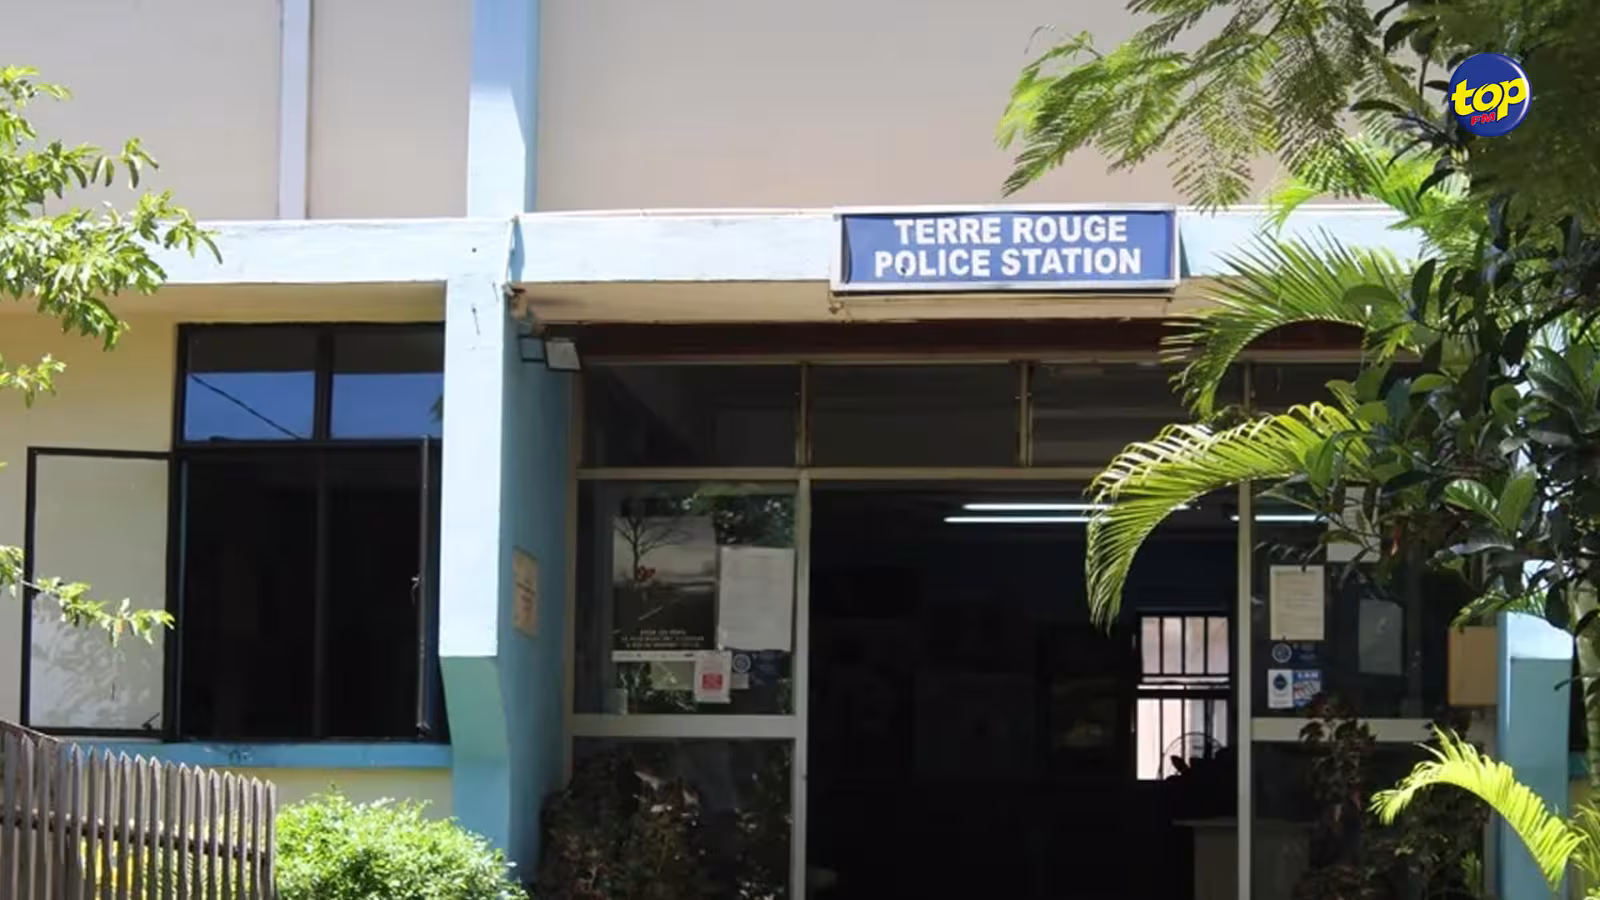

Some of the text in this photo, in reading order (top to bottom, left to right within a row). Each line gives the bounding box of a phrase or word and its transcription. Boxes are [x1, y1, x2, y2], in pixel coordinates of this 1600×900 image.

[893, 215, 1127, 245] TERRE ROUGE
[874, 247, 1141, 278] POLICE STATION
